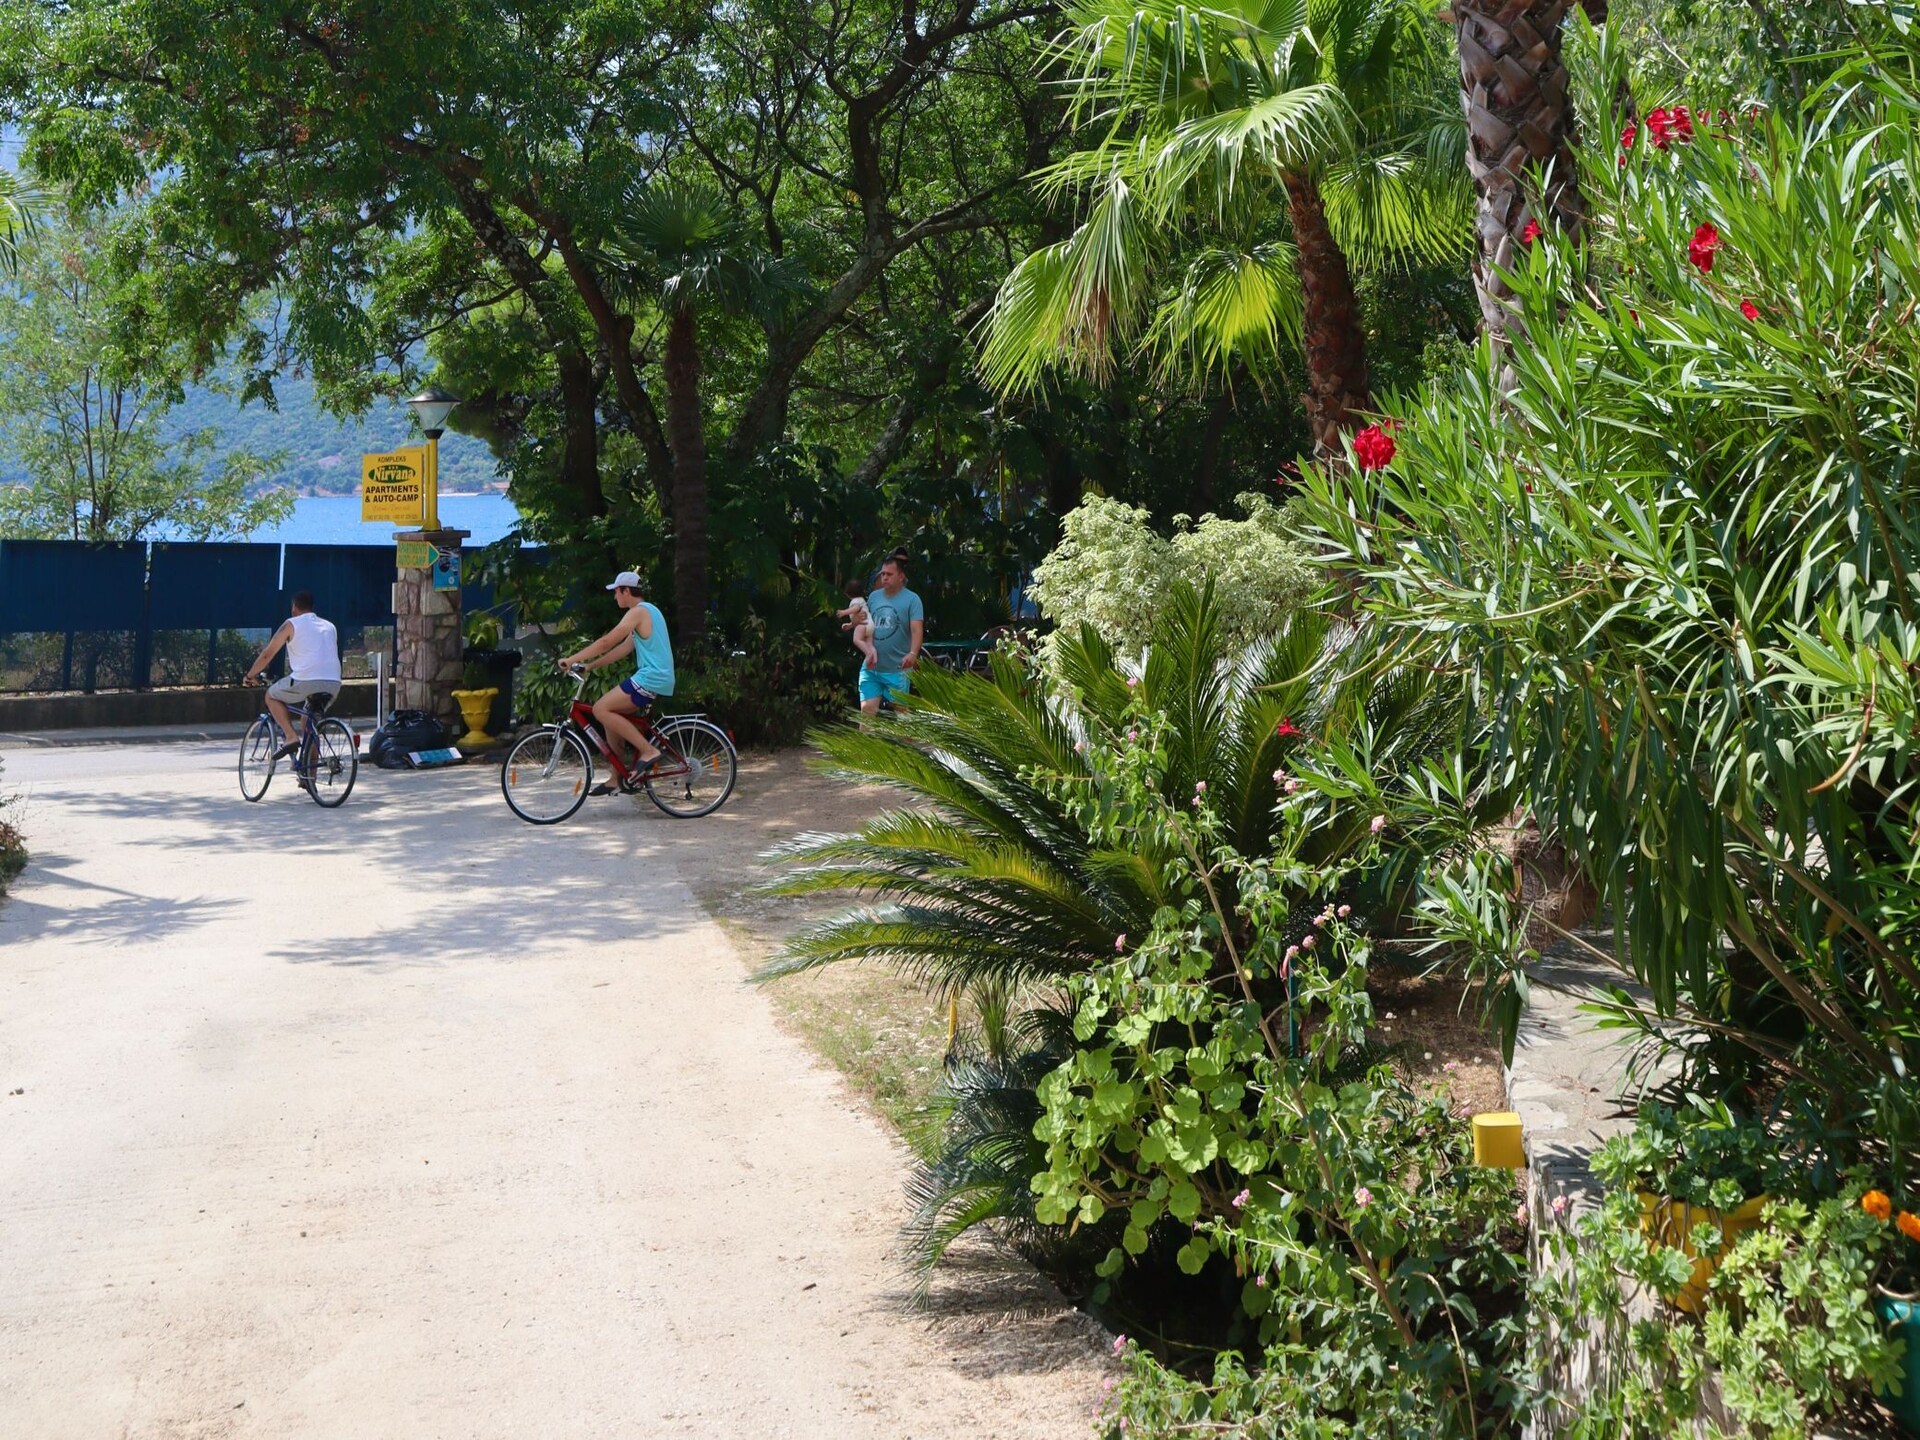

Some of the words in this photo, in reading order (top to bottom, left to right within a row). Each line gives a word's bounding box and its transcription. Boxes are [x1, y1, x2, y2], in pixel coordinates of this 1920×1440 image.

[377, 455, 407, 463] KOMPLEKS
[373, 466, 415, 482] Nirvana
[365, 484, 419, 494] APARTMENTS
[364, 495, 371, 503] &
[372, 494, 419, 503] AUTO-CAMP
